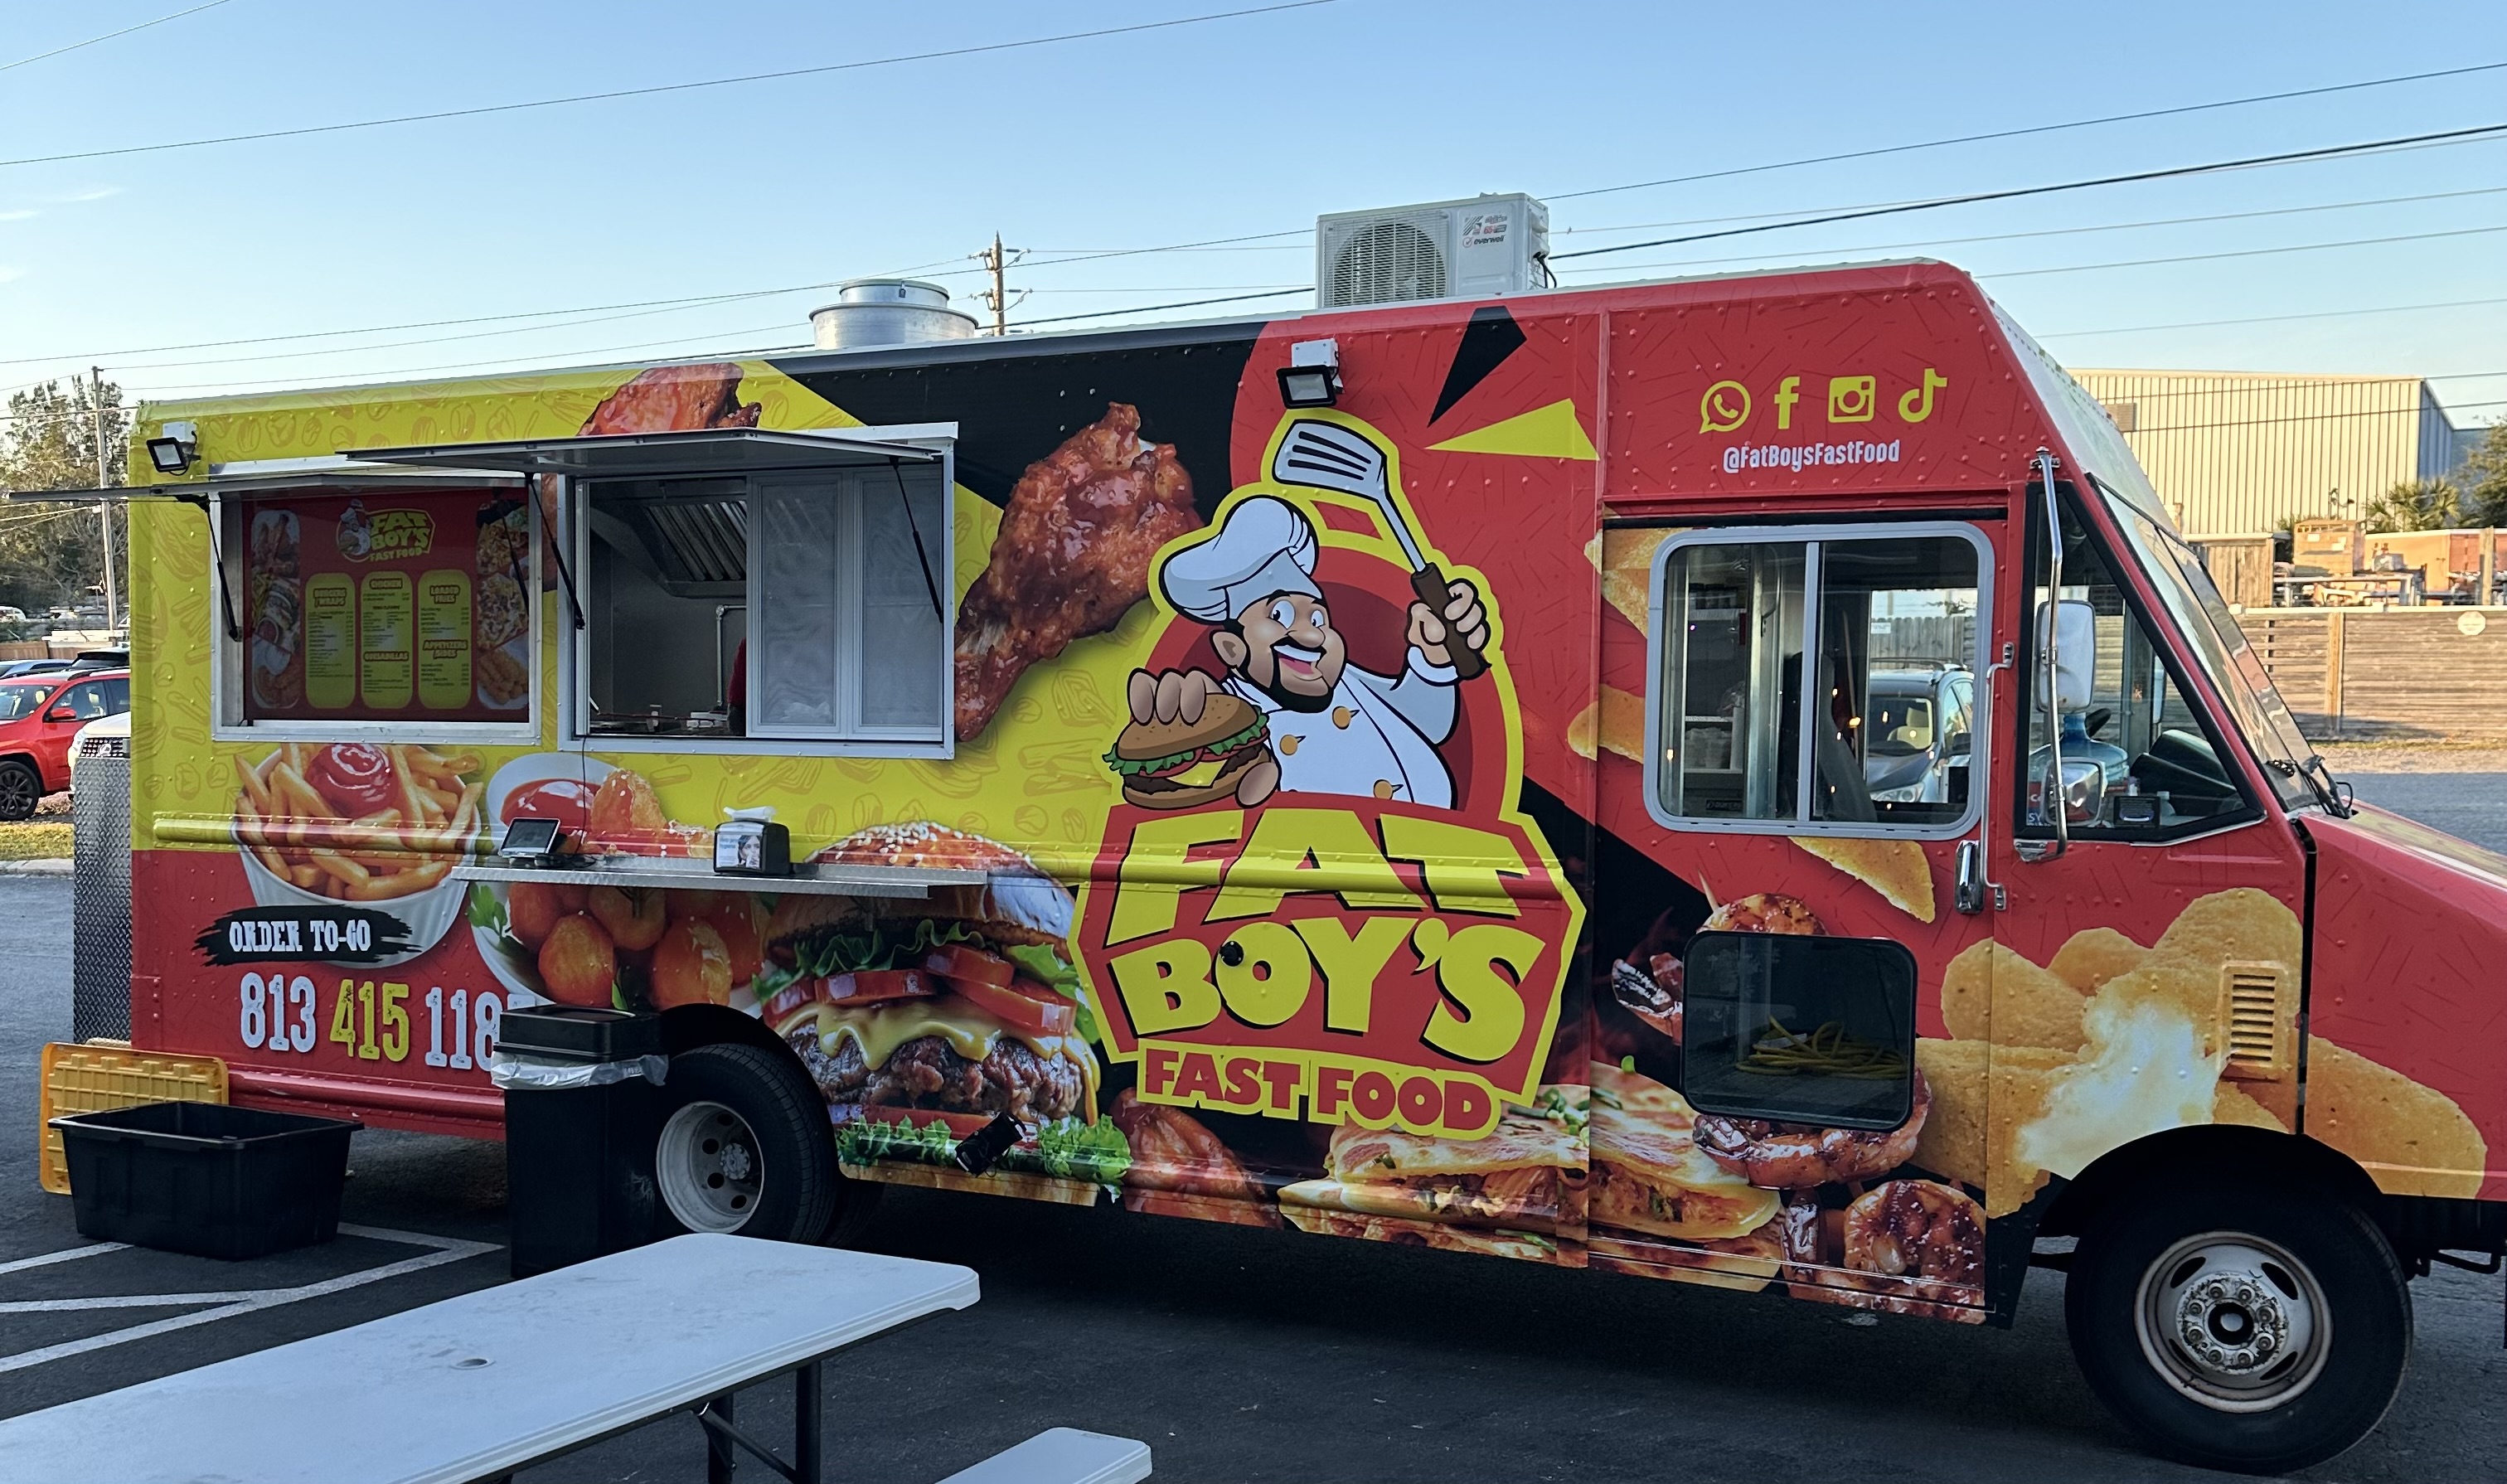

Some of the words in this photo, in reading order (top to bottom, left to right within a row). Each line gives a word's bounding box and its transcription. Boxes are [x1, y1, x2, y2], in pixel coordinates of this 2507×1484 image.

[1723, 439, 1900, 473] @FatBoysFastFood
[371, 512, 428, 536] FAT
[371, 527, 430, 551] BOY'S
[369, 551, 395, 562] FAST
[396, 547, 424, 560] FOOD
[1104, 808, 1532, 947] FAT
[229, 920, 303, 953] ORDER
[309, 919, 371, 952] TO-GO
[1108, 916, 1546, 1062] BOY'S
[240, 972, 316, 1053] 813
[329, 979, 410, 1062] 415
[425, 987, 536, 1072] 118
[1145, 1049, 1302, 1110] FAST
[1317, 1065, 1492, 1132] FOOD
